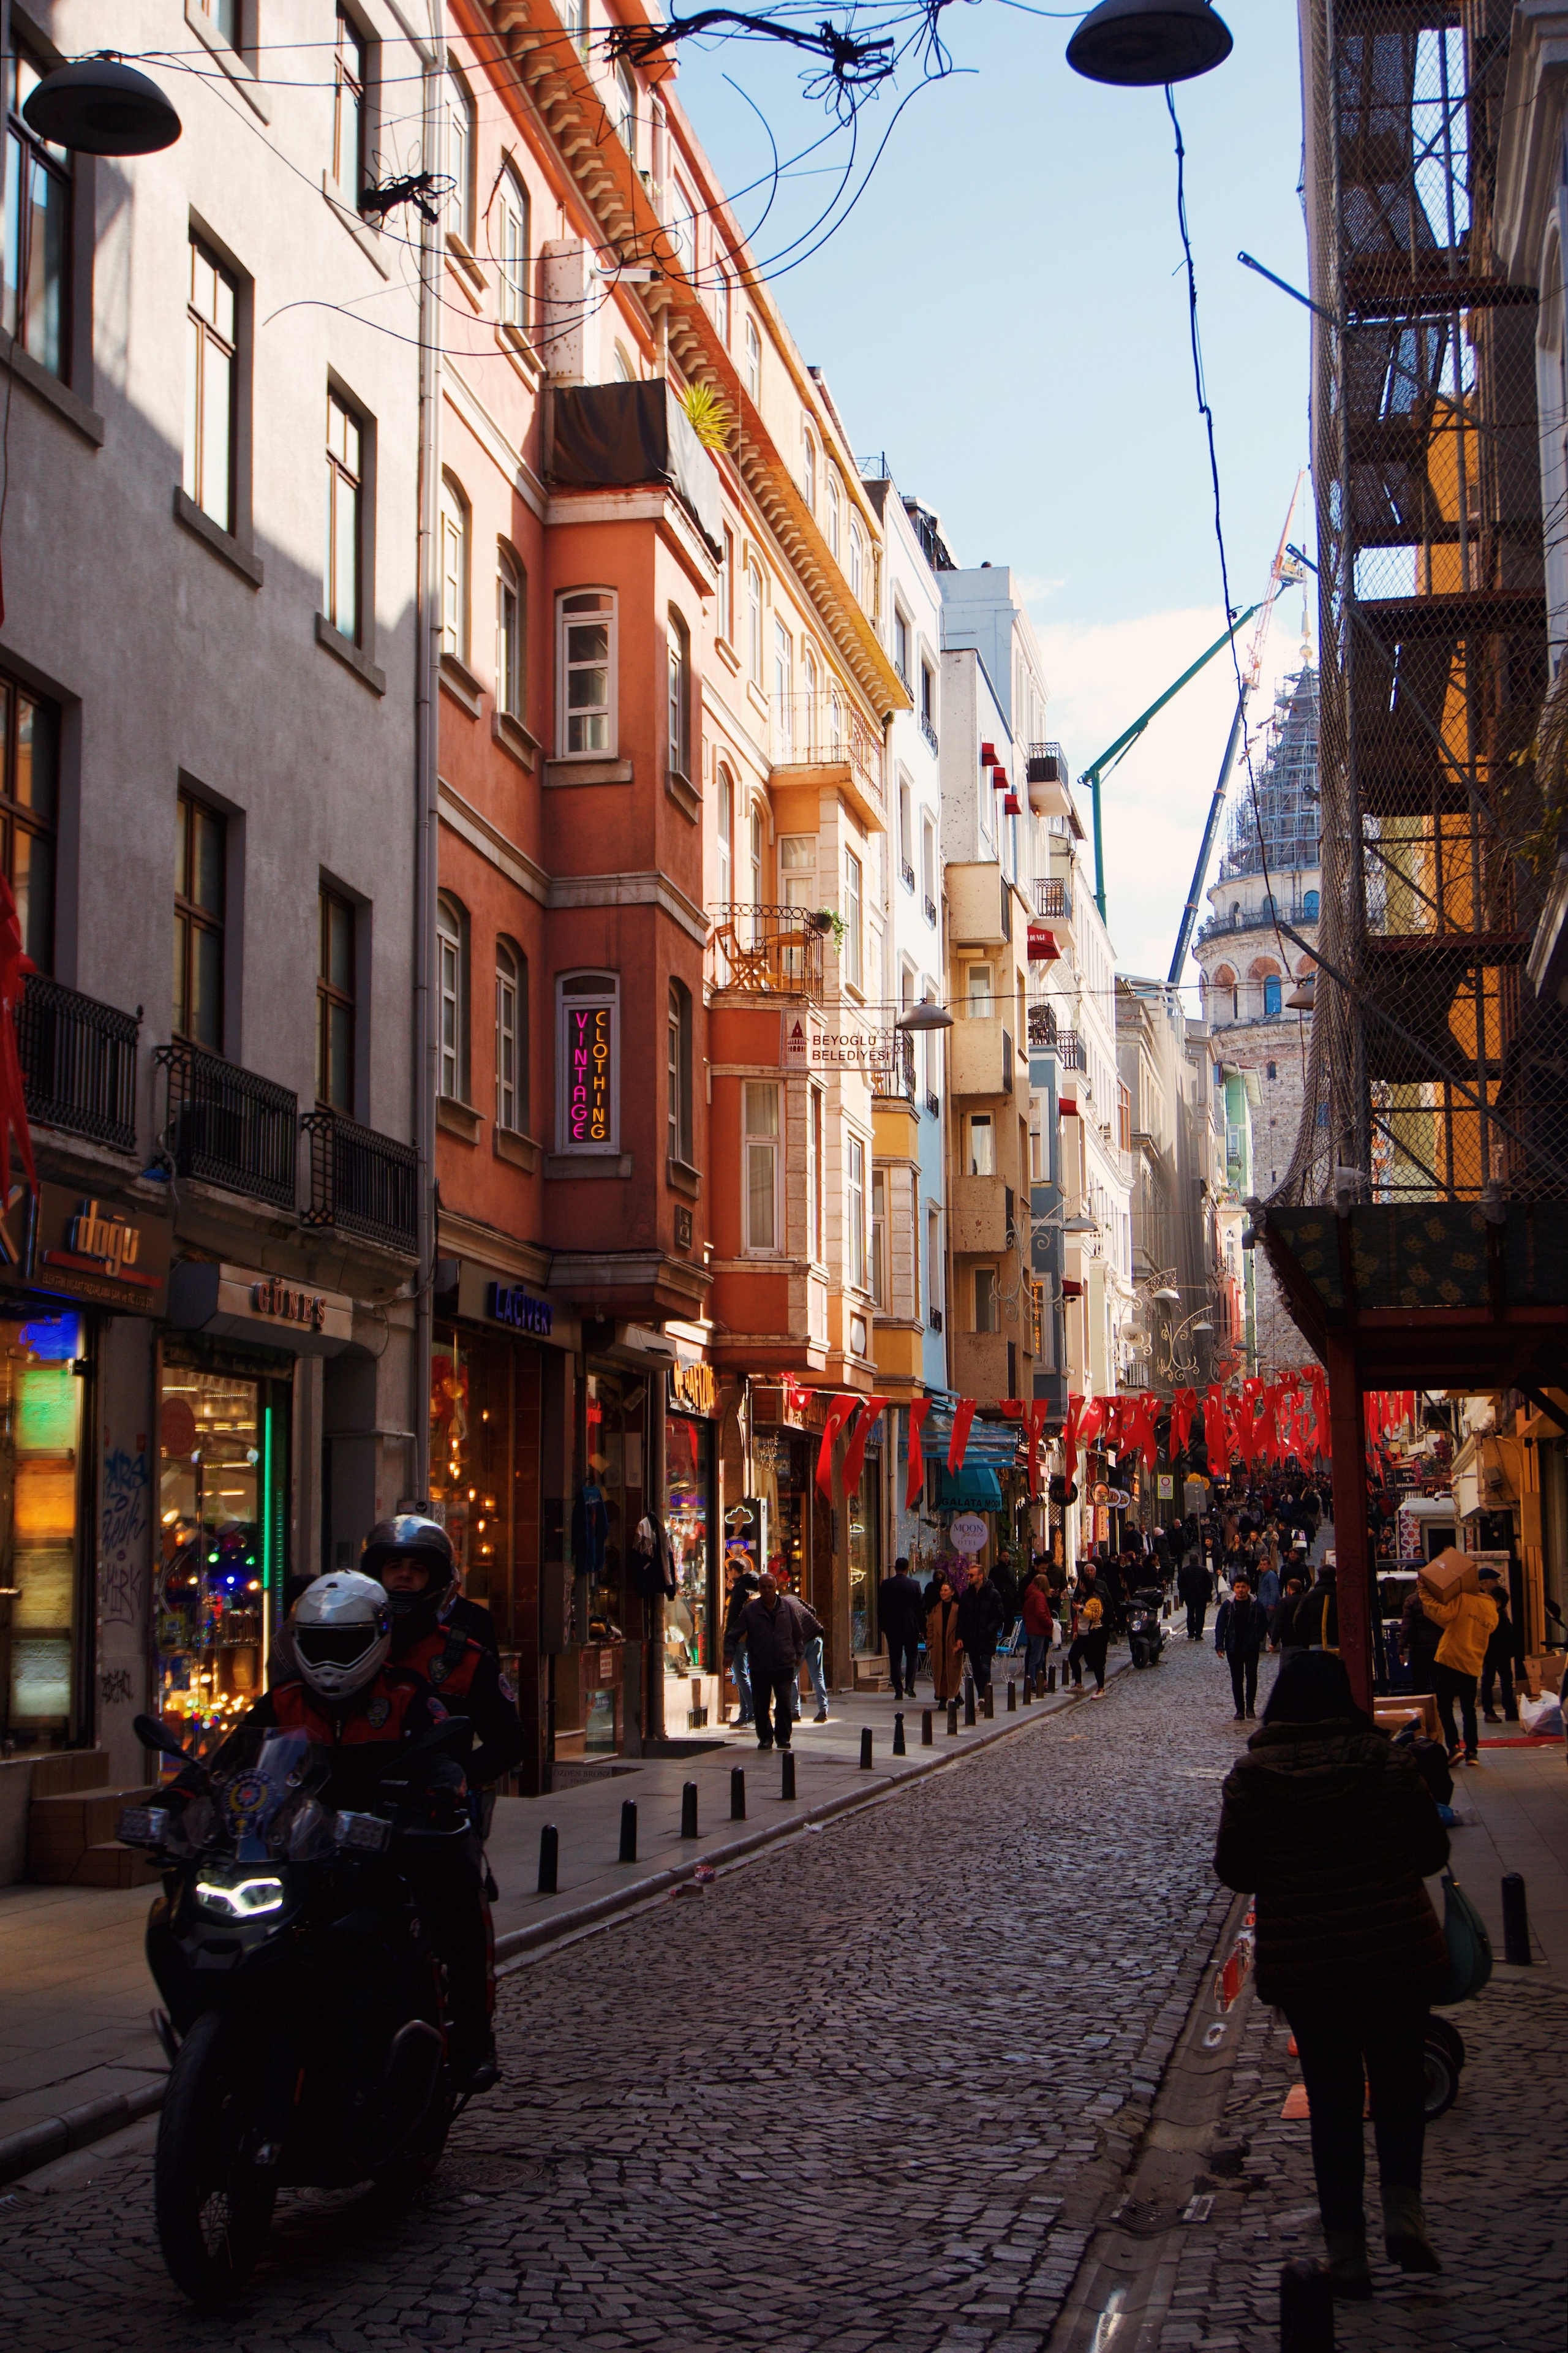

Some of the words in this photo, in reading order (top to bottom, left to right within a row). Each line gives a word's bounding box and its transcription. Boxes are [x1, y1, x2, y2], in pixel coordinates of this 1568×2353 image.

[813, 1032, 876, 1045] BEYOĞLU
[812, 1049, 889, 1060] BELEDİYESİ
[571, 1012, 589, 1139] VINTAGE
[590, 1011, 608, 1139] CLOTHING
[74, 1199, 140, 1278] doğu
[941, 1498, 982, 1506] GALATA
[954, 1524, 983, 1532] MOON
[553, 1769, 581, 1777] ÖZDEN
